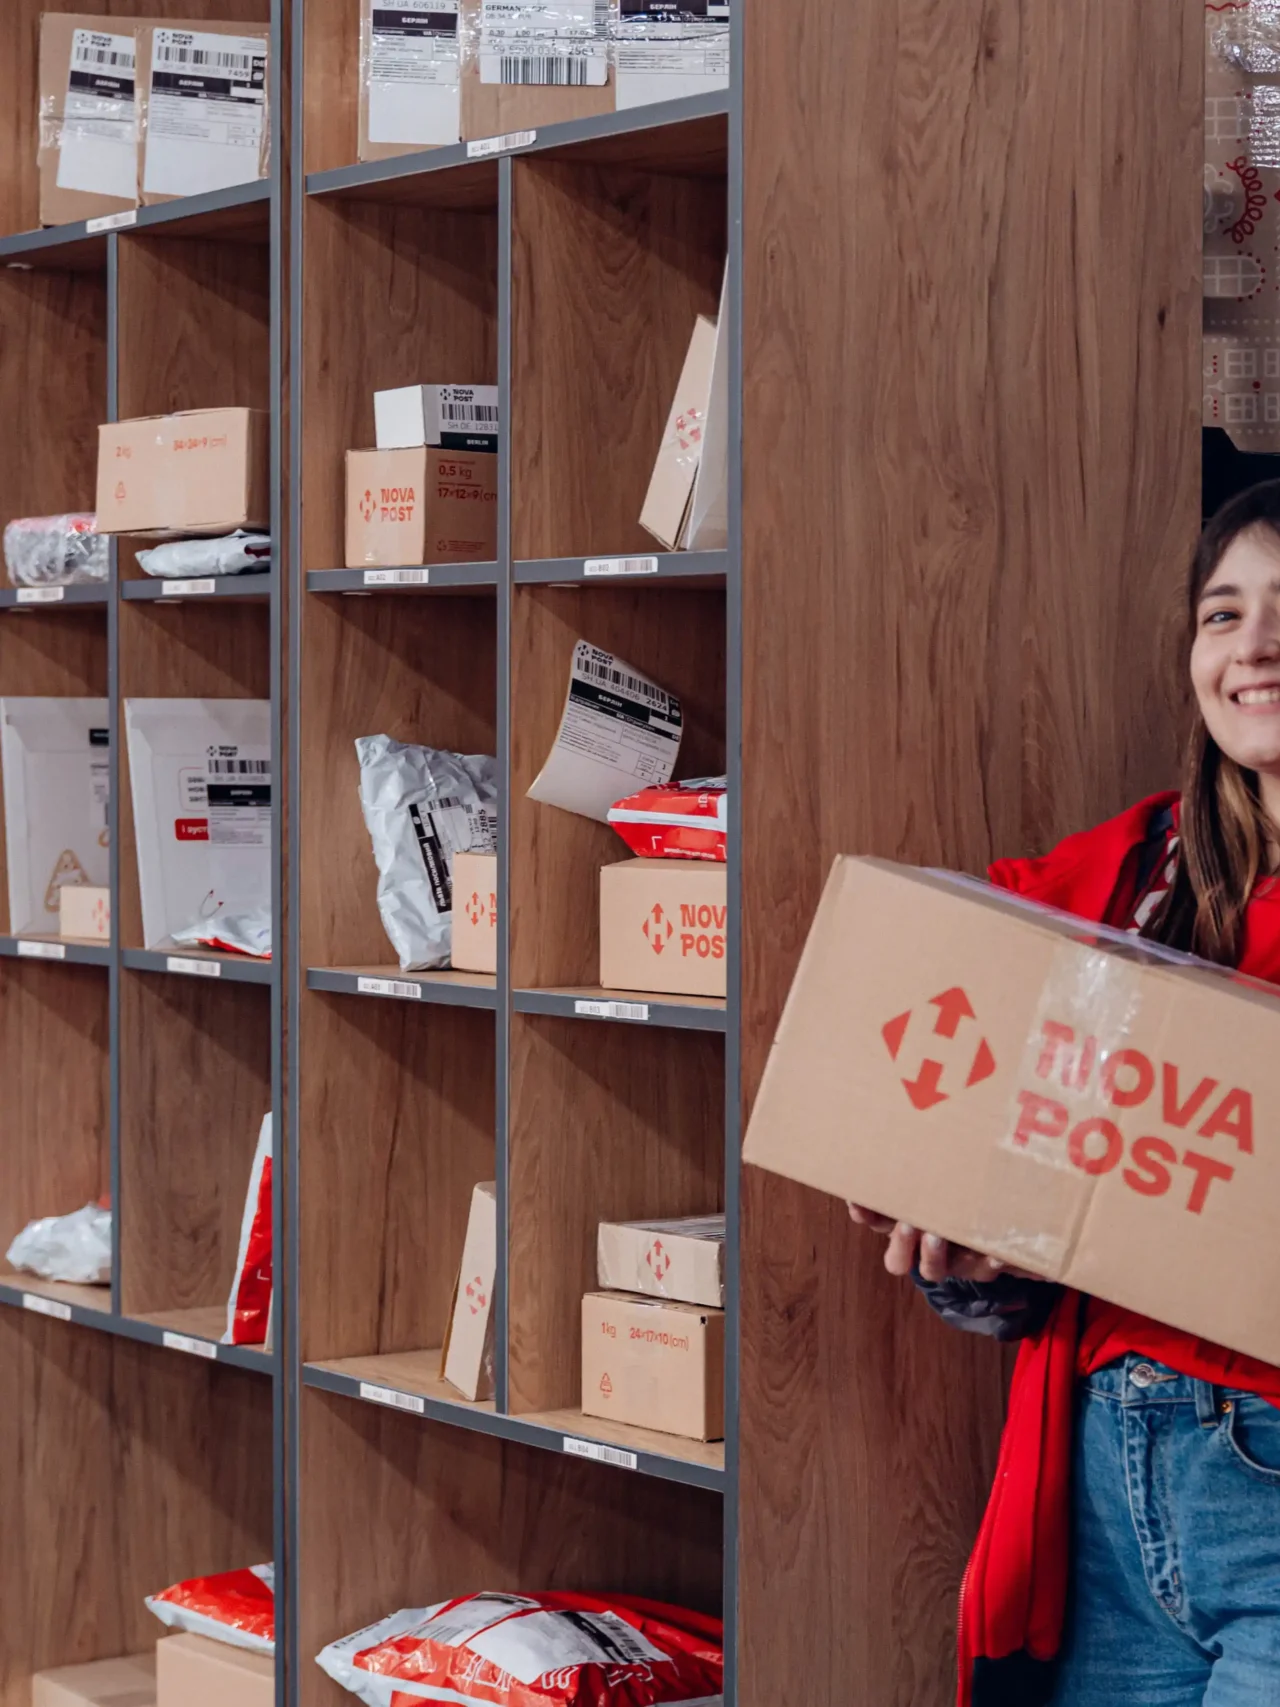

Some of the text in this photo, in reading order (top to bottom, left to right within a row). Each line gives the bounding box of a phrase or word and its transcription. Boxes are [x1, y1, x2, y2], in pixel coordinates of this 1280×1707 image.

[452, 388, 474, 396] NOVA
[380, 487, 416, 504] NOVA
[380, 506, 414, 522] POST
[591, 655, 613, 666] POST
[592, 648, 614, 660] NOVA
[598, 693, 623, 708] БЕРЛІН
[478, 807, 490, 834] 2885
[680, 903, 727, 930] NOV
[680, 933, 727, 960] POS
[1036, 1020, 1255, 1156] NOVA
[1013, 1089, 1235, 1216] POST
